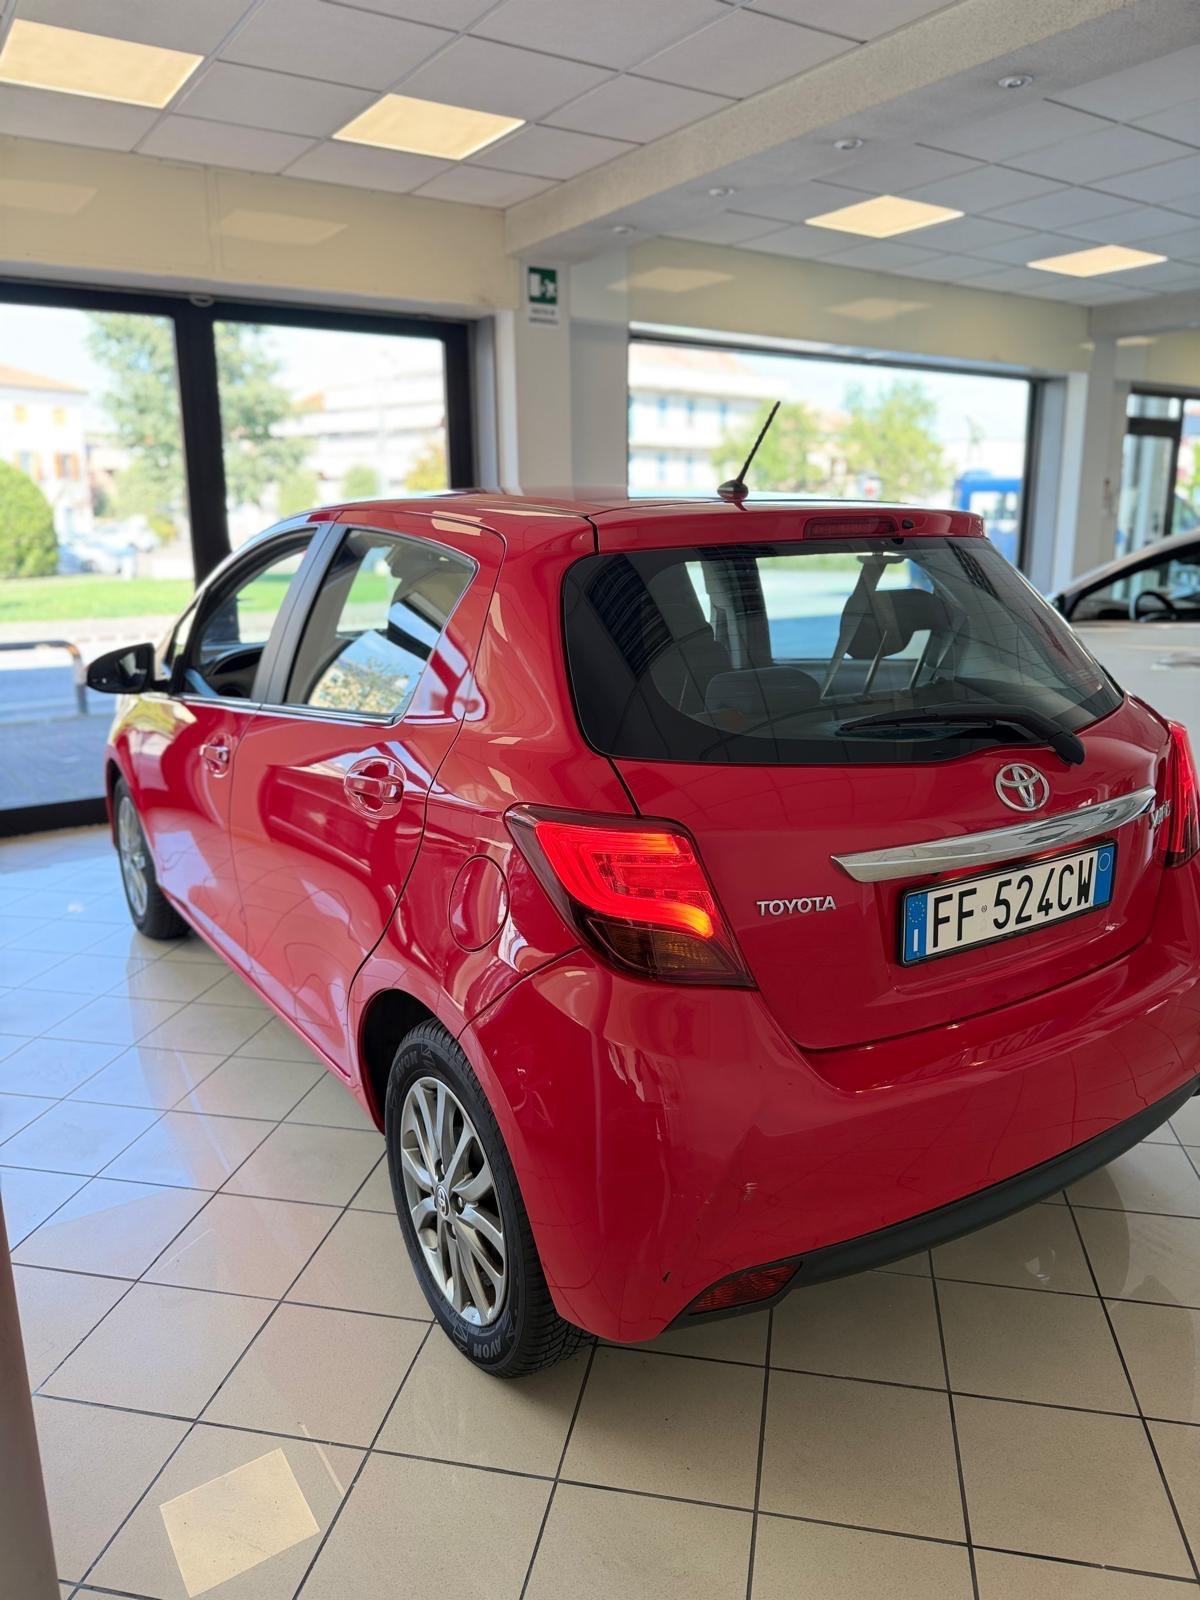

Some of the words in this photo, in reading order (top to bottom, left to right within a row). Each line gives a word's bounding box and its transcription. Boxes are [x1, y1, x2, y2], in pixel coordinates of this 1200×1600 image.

[756, 895, 837, 916] TOYOTA
[932, 887, 977, 948] FF
[992, 856, 1094, 930] 524CW
[473, 1335, 502, 1359] AVON
